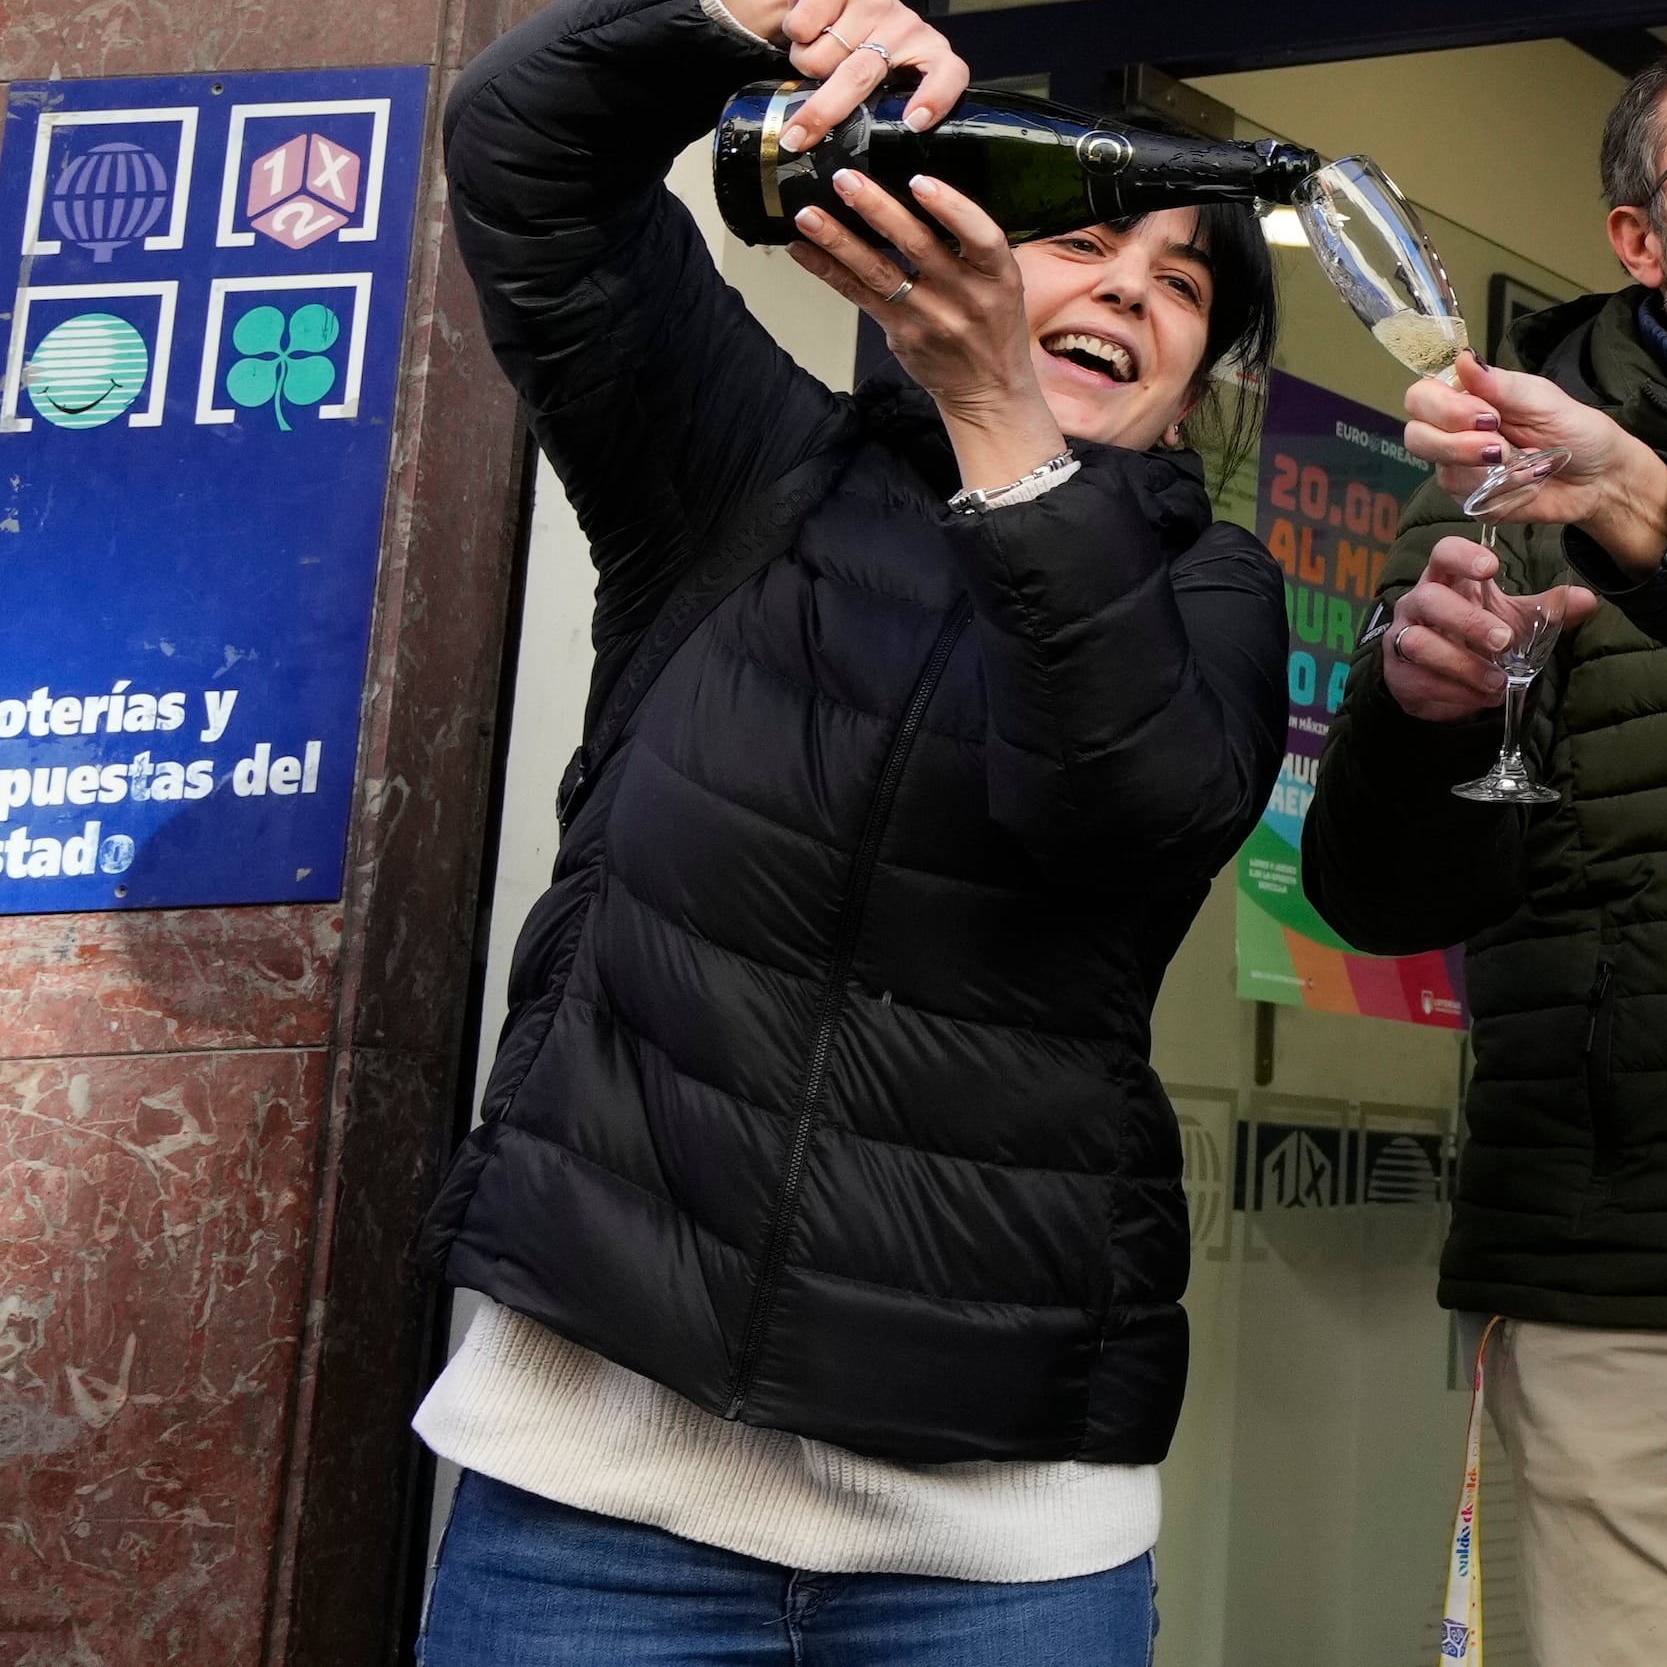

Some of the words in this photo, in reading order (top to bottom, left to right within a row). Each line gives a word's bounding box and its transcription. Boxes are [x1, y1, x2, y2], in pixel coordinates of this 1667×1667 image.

[1335, 420, 1370, 447] EURO
[1268, 517, 1327, 585] AL
[200, 690, 240, 743] y
[233, 740, 322, 798] del
[0, 821, 136, 880] tado
